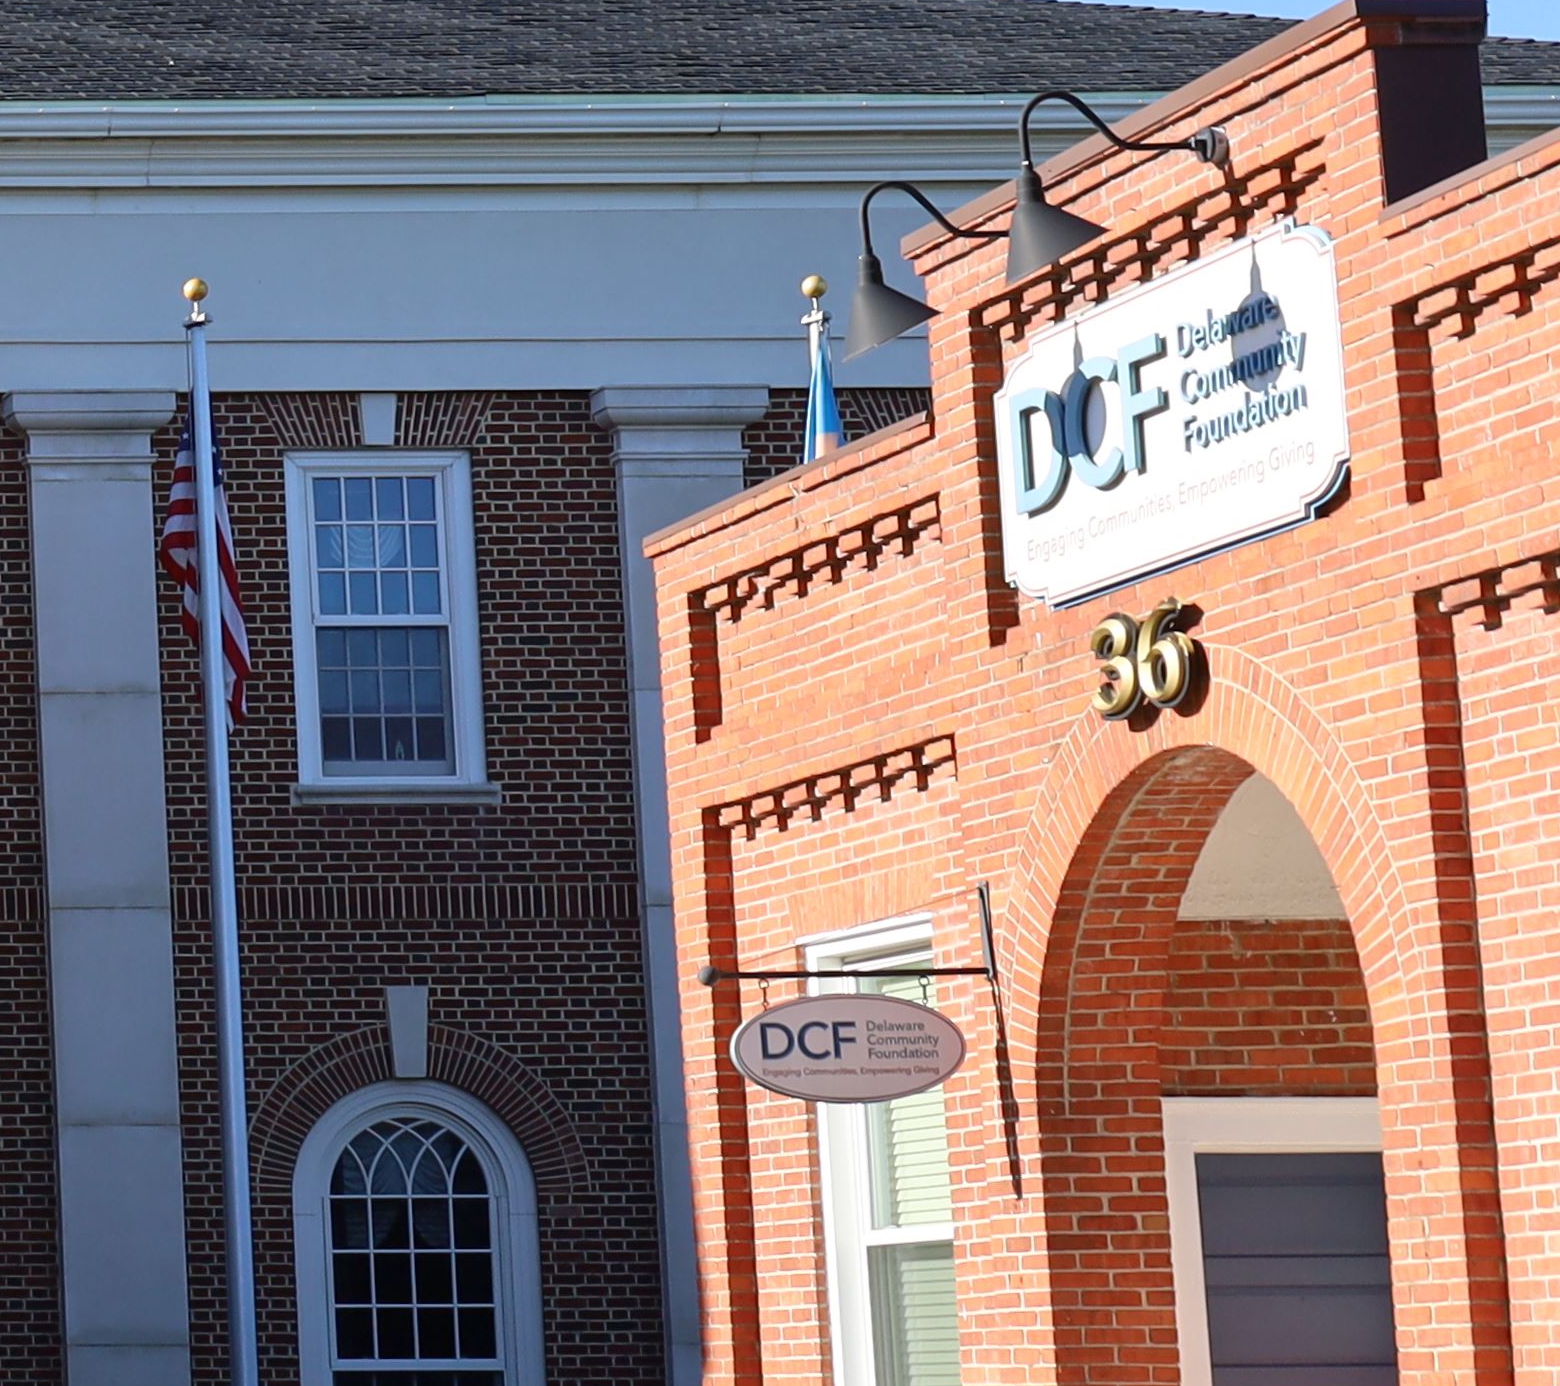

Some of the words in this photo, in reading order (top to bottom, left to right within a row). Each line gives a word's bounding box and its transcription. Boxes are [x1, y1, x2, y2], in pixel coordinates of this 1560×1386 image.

[1176, 295, 1280, 360] Delaware
[1180, 329, 1307, 406] Community
[1009, 332, 1169, 518] DCF
[1183, 383, 1308, 452] Foundation
[1027, 529, 1086, 562] Engaging
[1088, 493, 1176, 539] Communities,
[1178, 459, 1265, 505] Empowering
[1269, 440, 1315, 472] Giving
[1091, 596, 1190, 720] 36
[759, 1021, 857, 1060] DCF
[866, 1020, 925, 1032] Delaware
[867, 1034, 940, 1048] Community
[868, 1048, 939, 1060] Foundation
[762, 1067, 801, 1078] Engaging
[860, 1065, 912, 1077] Empowering
[914, 1065, 940, 1077] Giving
